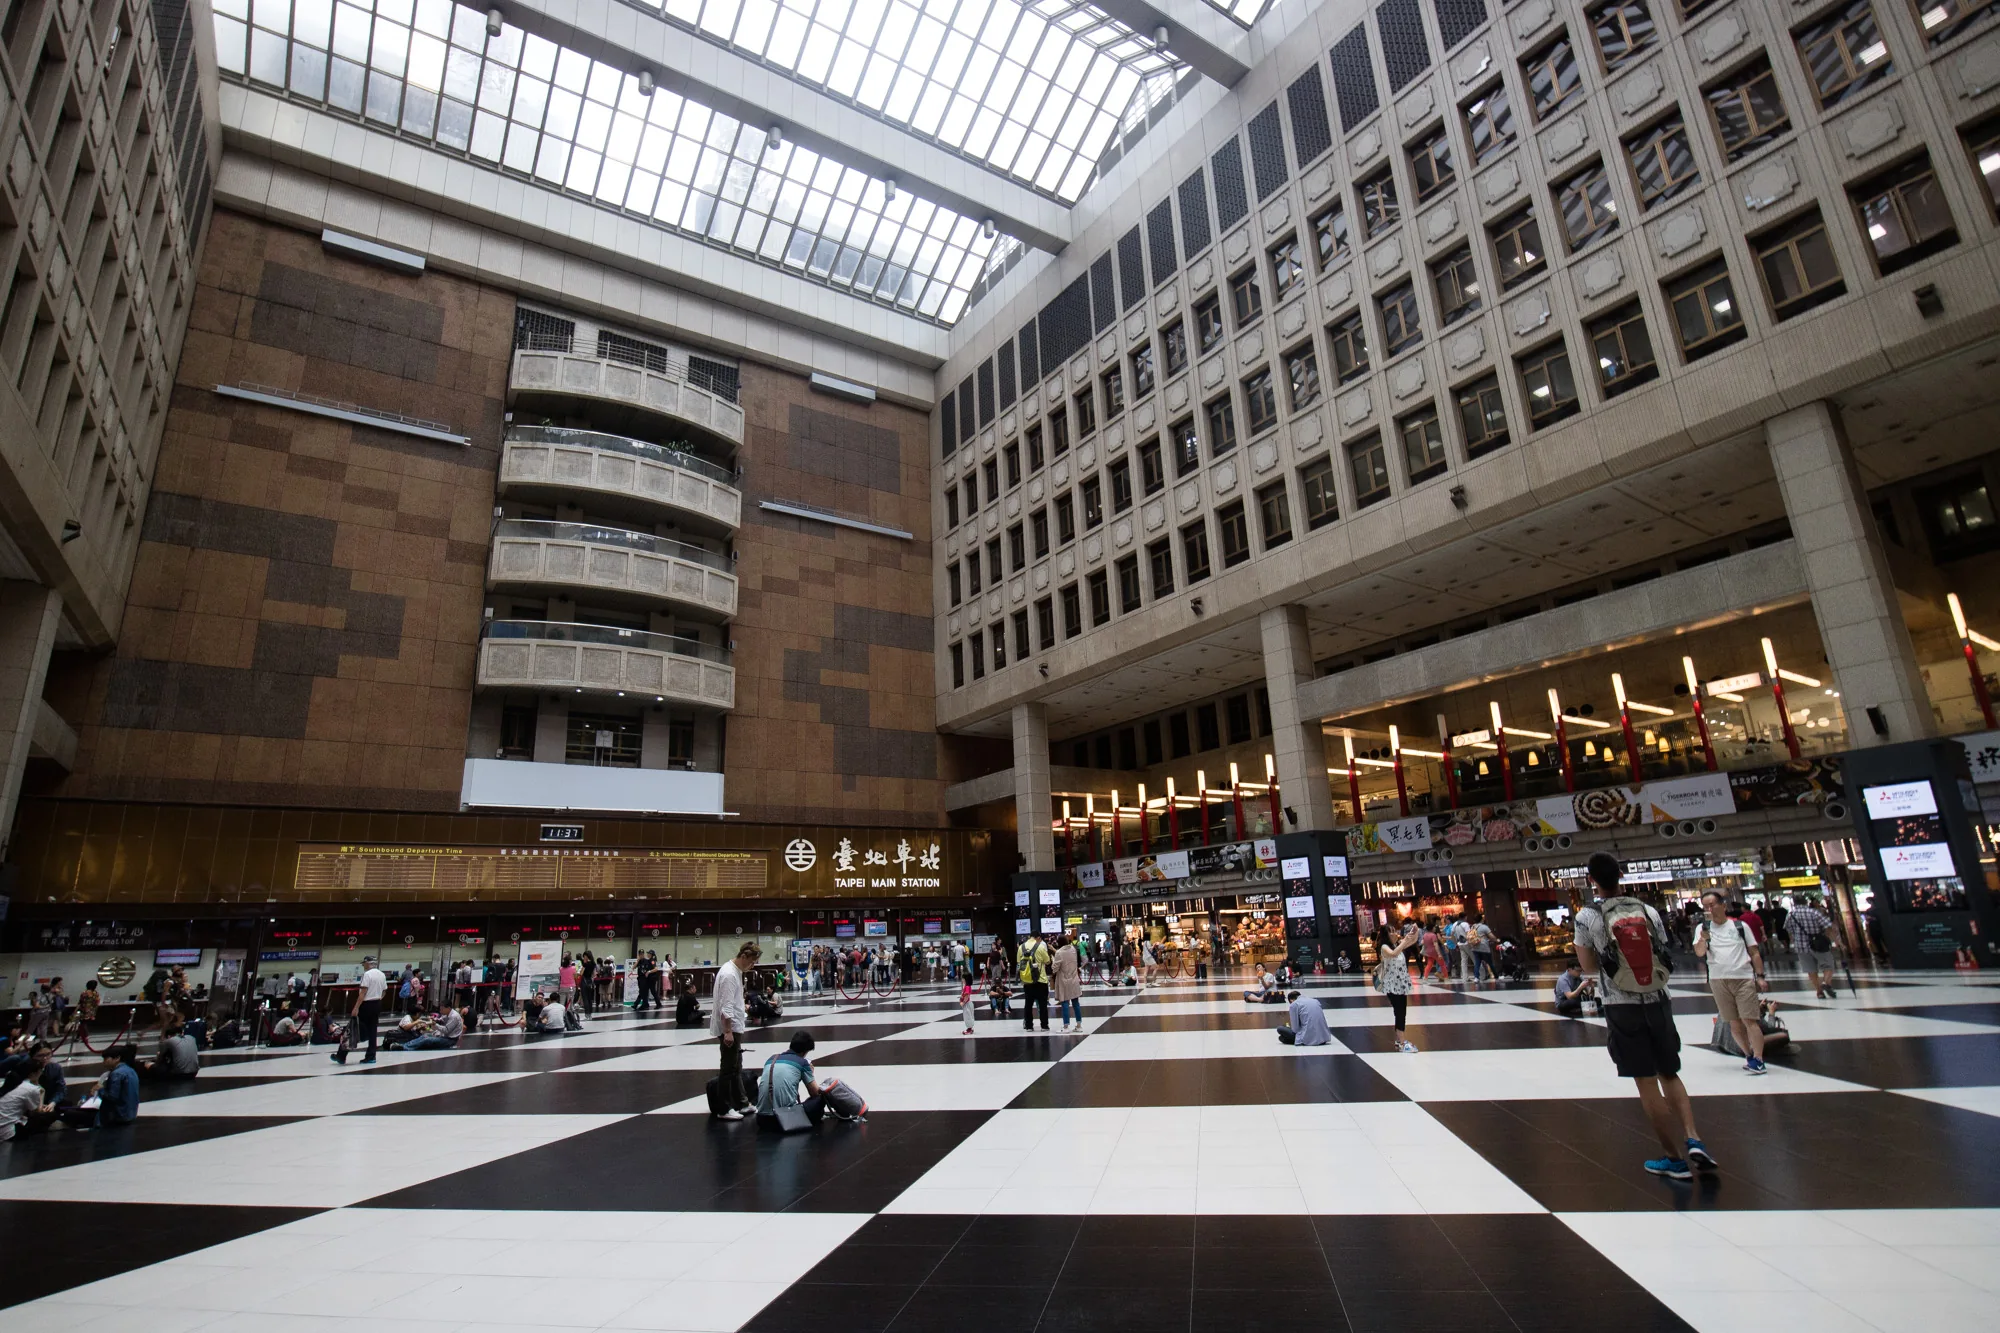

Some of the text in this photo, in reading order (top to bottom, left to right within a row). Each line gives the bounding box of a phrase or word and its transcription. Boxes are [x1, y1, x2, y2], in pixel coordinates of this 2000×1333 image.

[550, 828, 578, 838] 11:37
[1386, 823, 1426, 844] 黑毛屋
[832, 836, 940, 874] 臺北車站
[834, 878, 940, 888] TAIPEI MAIN STATION
[79, 928, 143, 937] 服務中心
